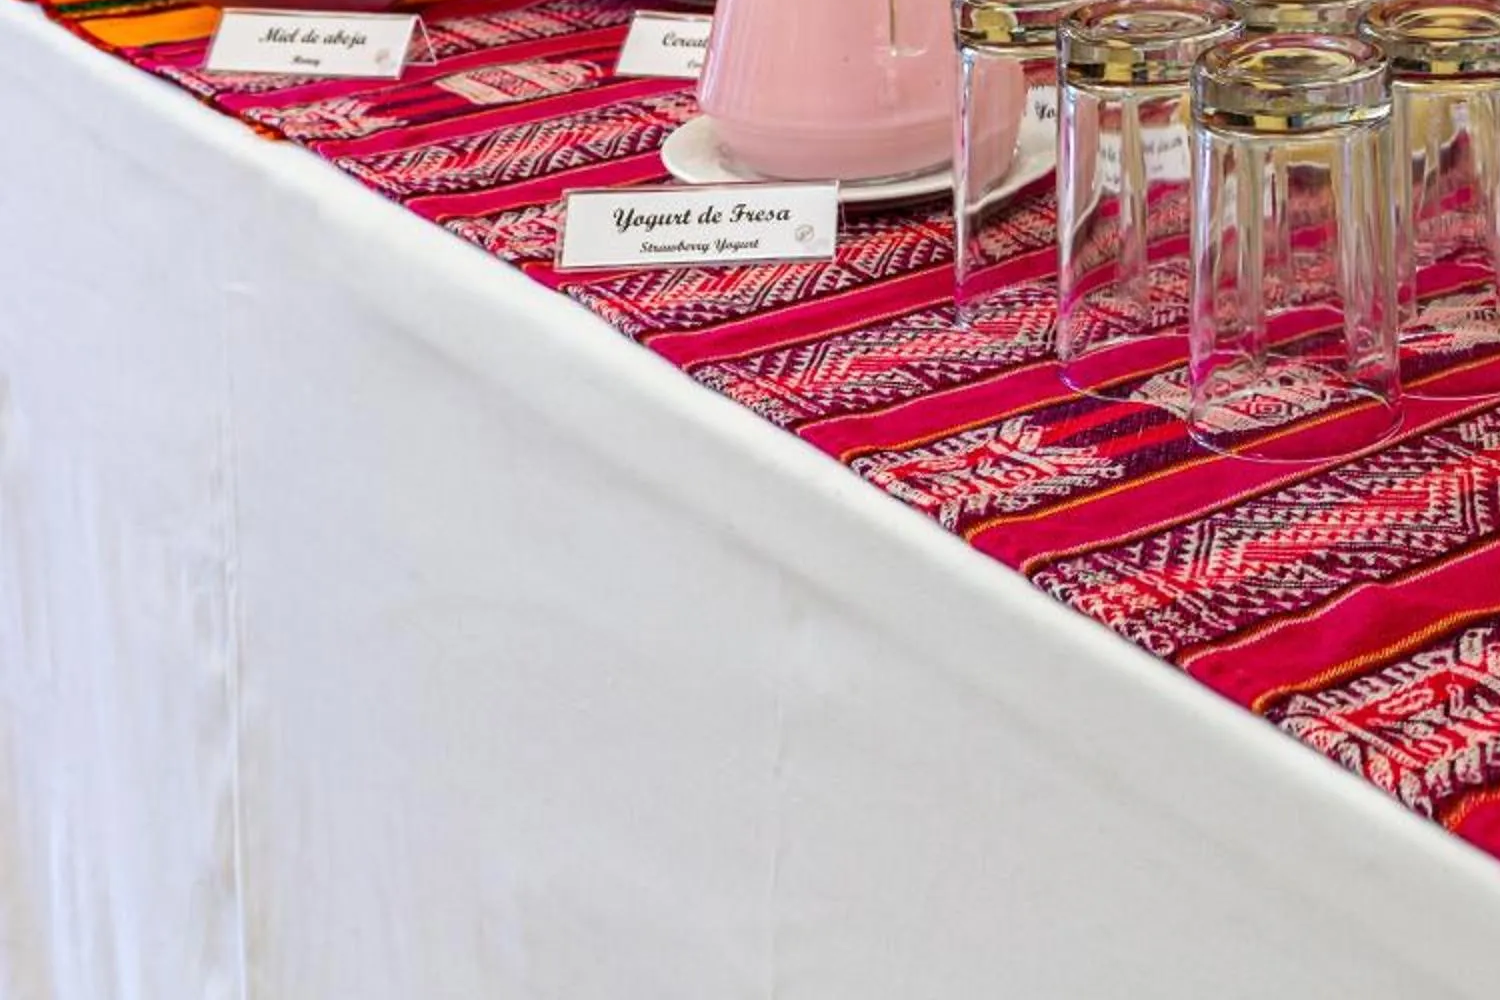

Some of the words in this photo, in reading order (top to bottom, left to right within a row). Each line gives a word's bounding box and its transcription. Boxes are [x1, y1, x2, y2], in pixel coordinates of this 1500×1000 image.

[258, 26, 296, 45] Miel
[301, 28, 319, 45] de
[323, 30, 367, 49] abeja
[613, 206, 691, 233] Yogurt
[697, 205, 722, 225] de
[729, 203, 791, 223] Fresa
[639, 240, 710, 254] Strawberry
[714, 238, 760, 253] Yogurt
